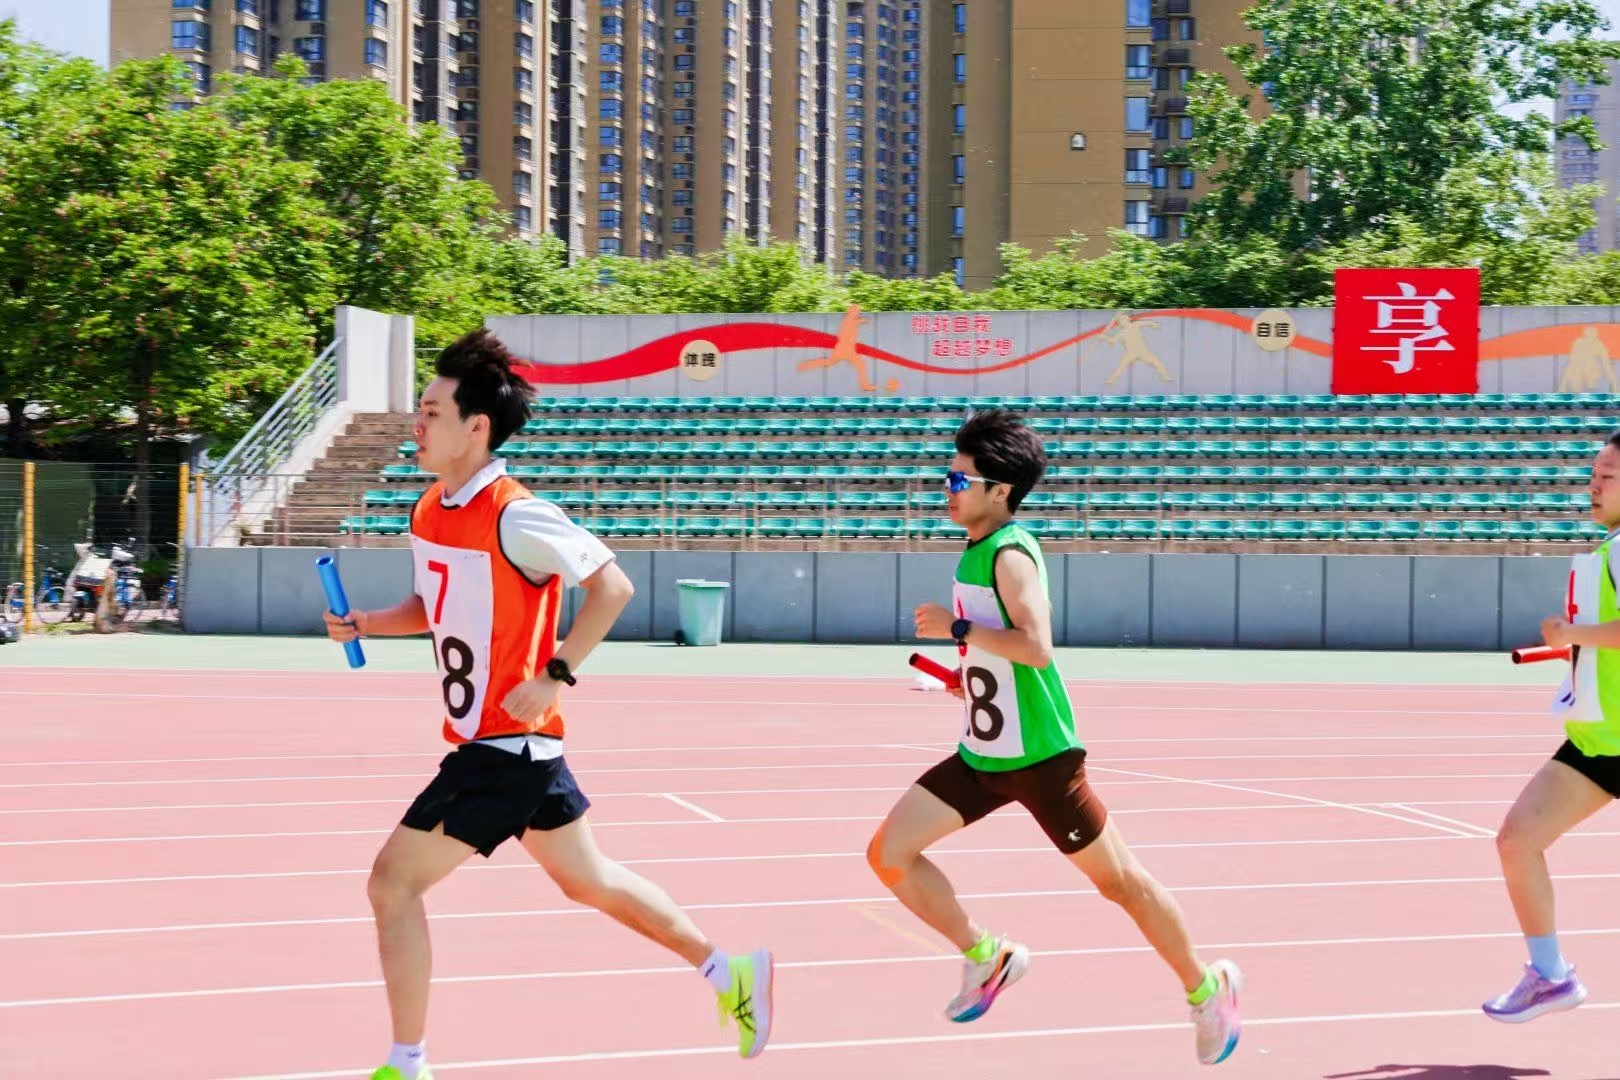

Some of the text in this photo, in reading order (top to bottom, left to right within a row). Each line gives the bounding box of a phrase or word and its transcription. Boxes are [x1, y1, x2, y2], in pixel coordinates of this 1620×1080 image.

[932, 338, 1013, 357] 超越梦想
[1257, 322, 1290, 337] 自信
[1360, 281, 1456, 374] 享
[427, 560, 448, 624] 7
